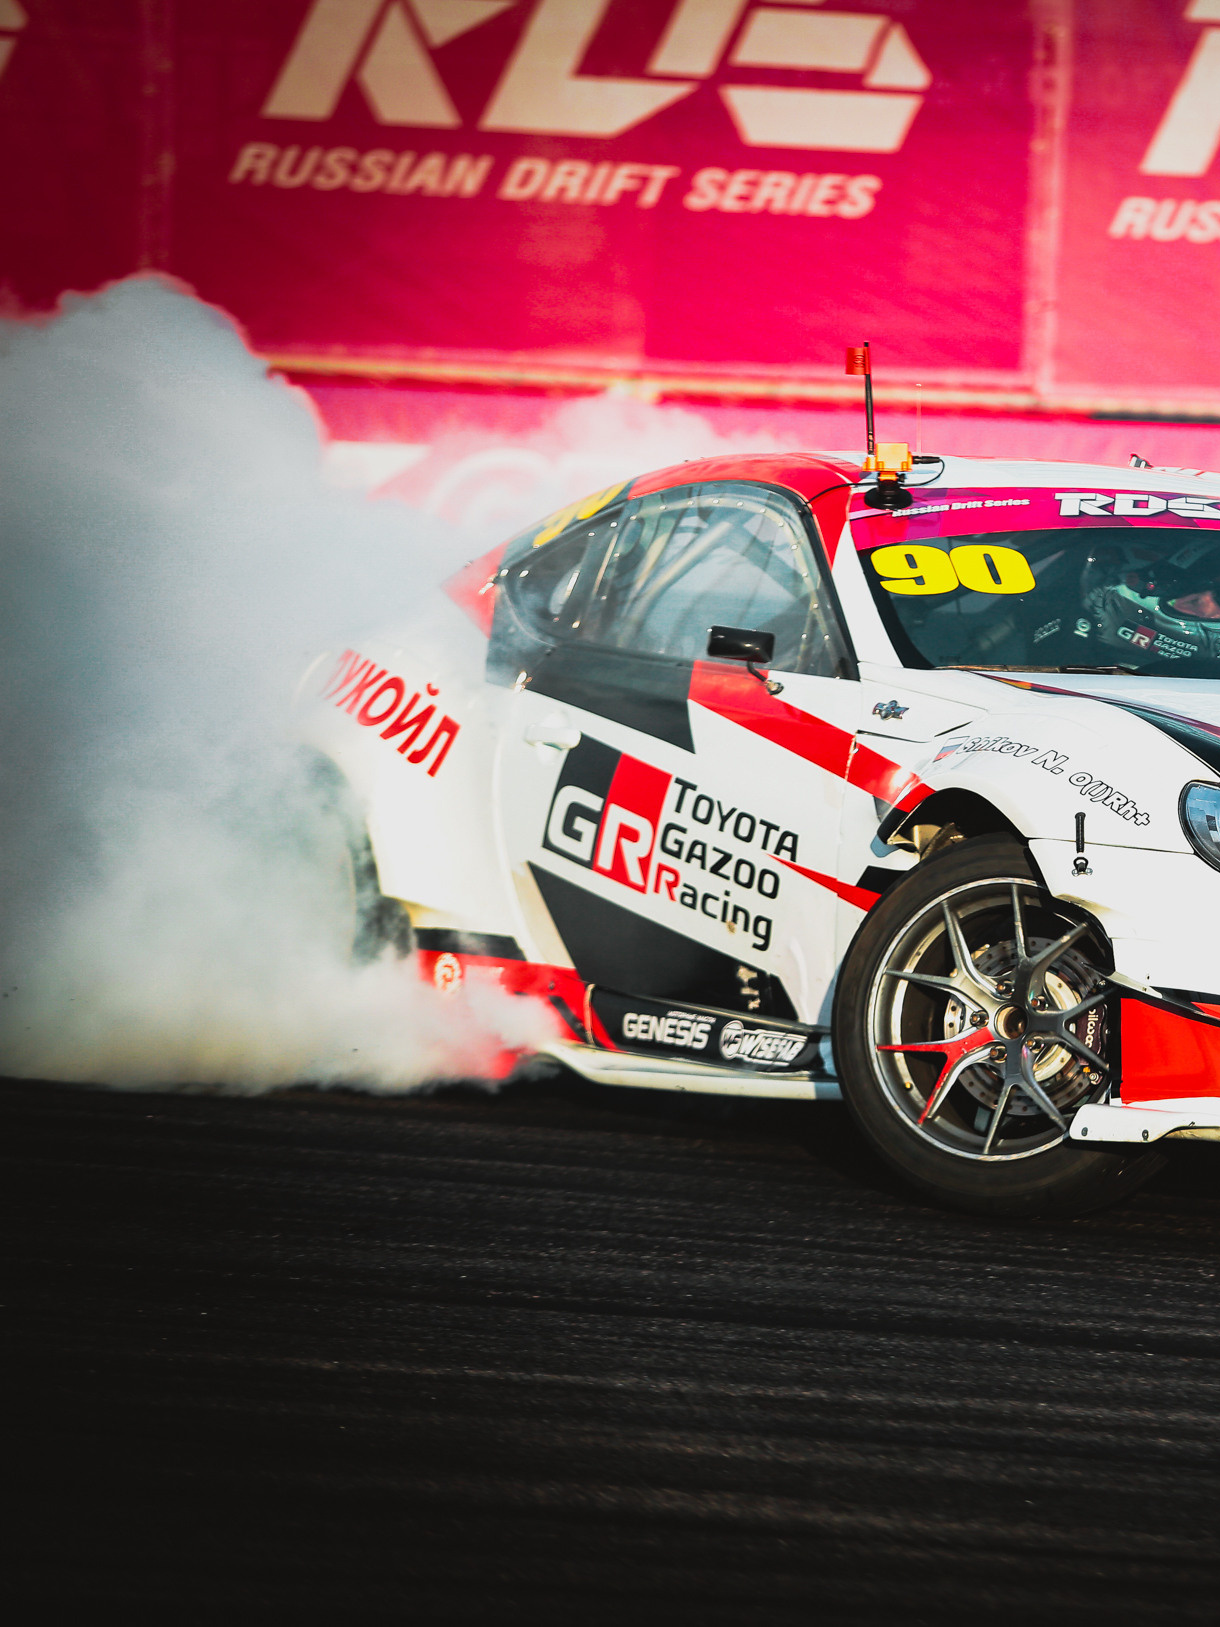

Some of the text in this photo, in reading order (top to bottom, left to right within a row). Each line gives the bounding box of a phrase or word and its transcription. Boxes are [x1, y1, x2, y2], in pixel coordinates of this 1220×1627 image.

[229, 142, 883, 219] RUSSIAN DRIFT SERIES
[951, 501, 983, 511] Drift
[984, 499, 1030, 508] Series
[869, 544, 1037, 596] 90
[1116, 626, 1151, 649] GR
[1153, 640, 1192, 657] GAZOO
[1157, 633, 1198, 651] TOYOTA
[546, 785, 655, 890] GR
[673, 777, 800, 862] TOYOTA
[660, 823, 781, 900] GAZOO
[655, 863, 773, 952] Racing
[623, 1012, 712, 1050] GENESIS
